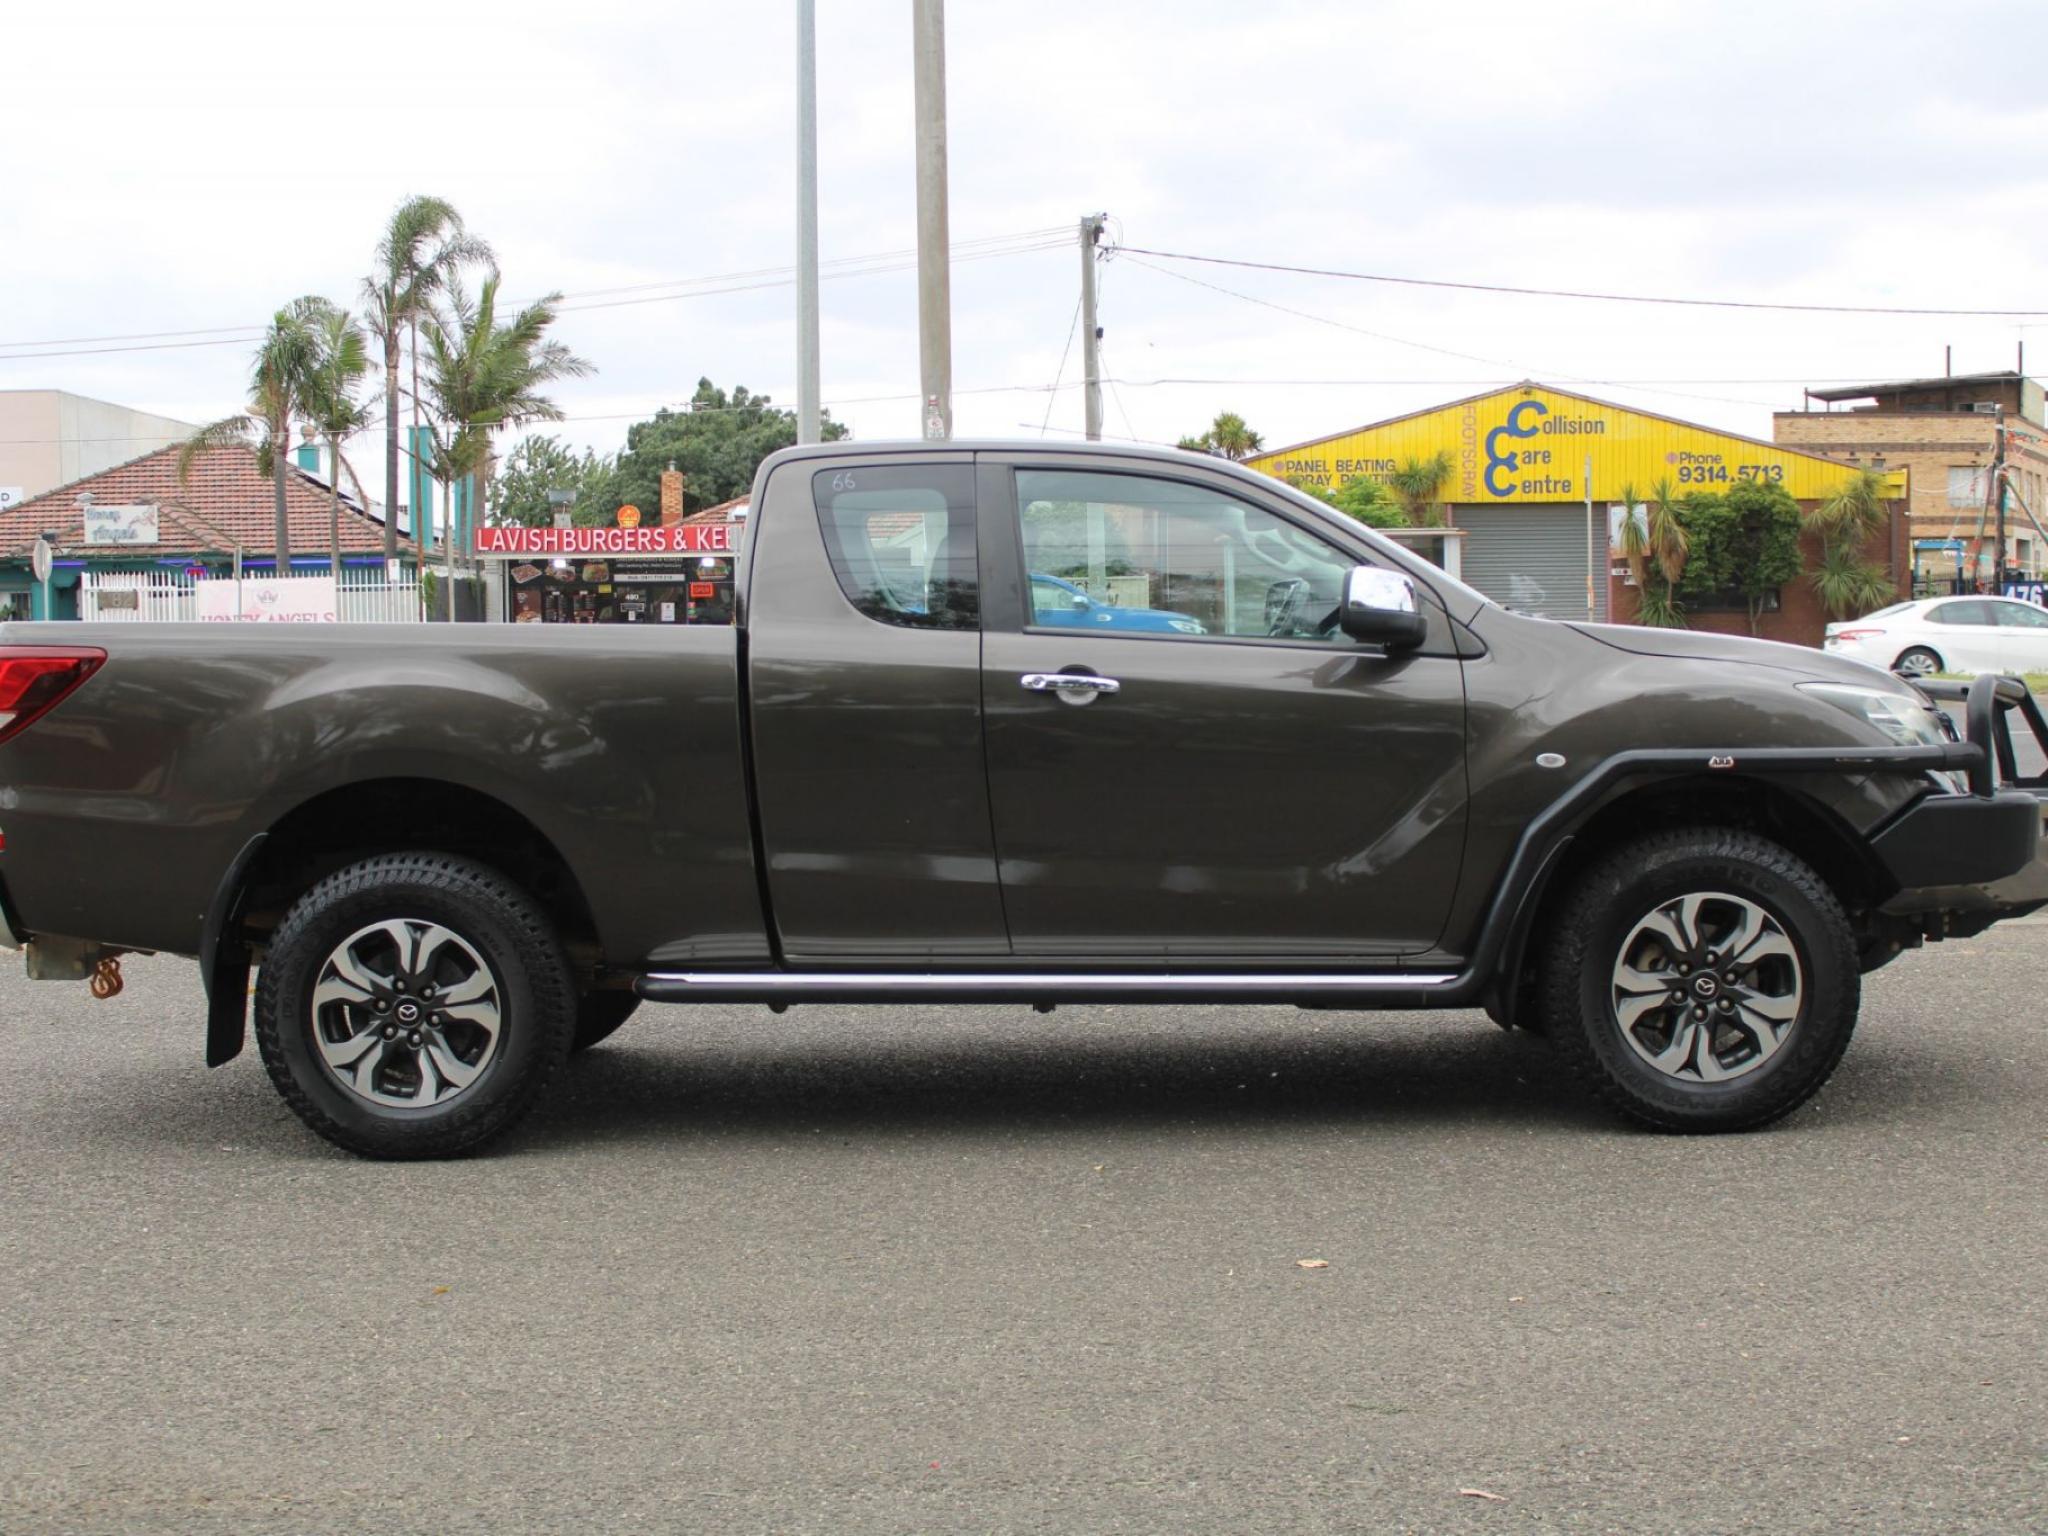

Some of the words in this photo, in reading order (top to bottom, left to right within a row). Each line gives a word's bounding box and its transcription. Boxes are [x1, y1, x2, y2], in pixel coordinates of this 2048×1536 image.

[1507, 400, 1605, 438] Collision
[1462, 405, 1477, 498] FOOTSCRAY
[1679, 452, 1722, 464] Phone
[1286, 460, 1330, 473] PANEL
[1335, 459, 1397, 473] BEATING
[832, 473, 856, 491] 66
[1484, 459, 1571, 497] Centre
[477, 530, 557, 551] LAVISH
[563, 529, 666, 551] BURGERS
[673, 530, 687, 550] &
